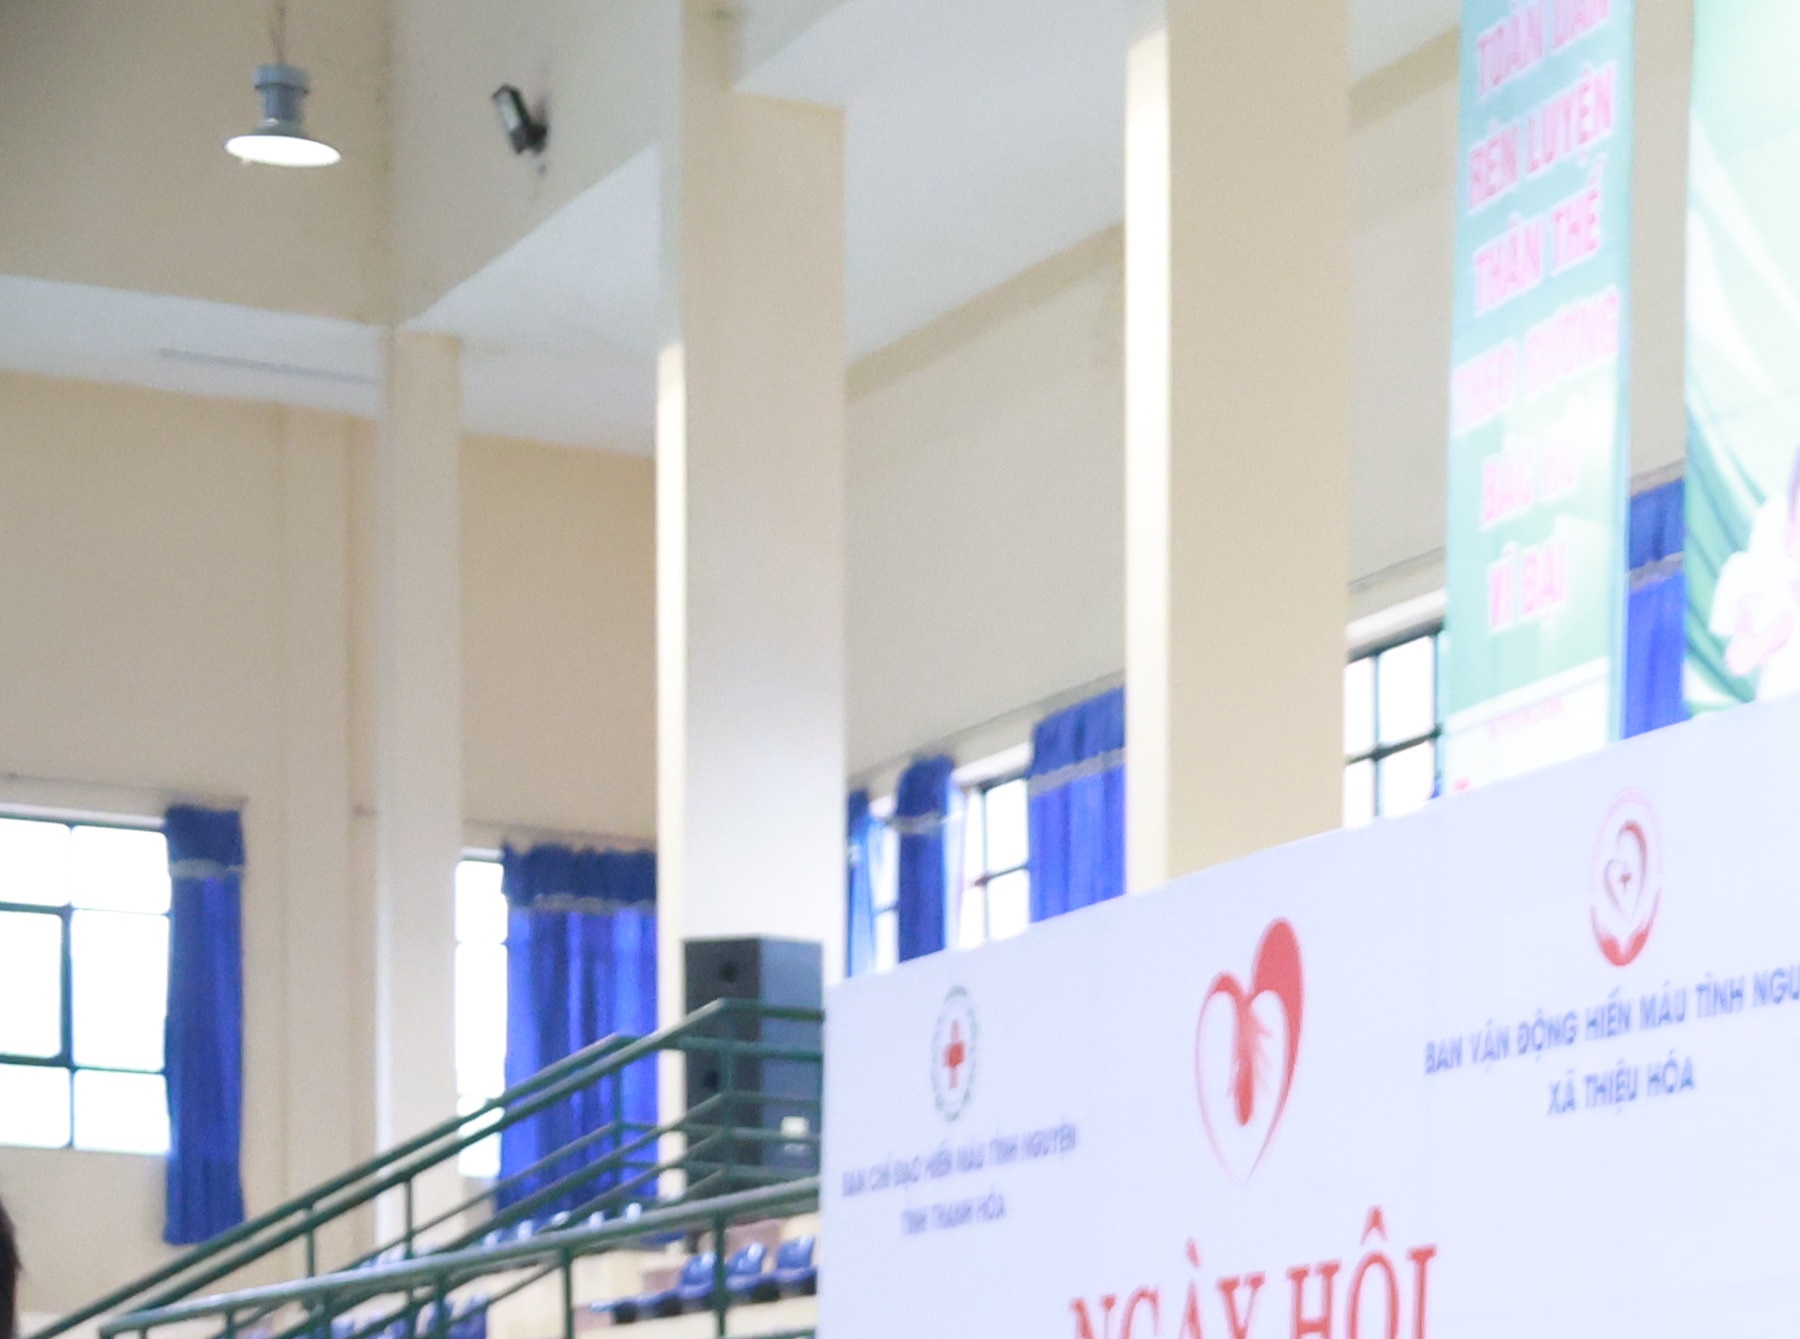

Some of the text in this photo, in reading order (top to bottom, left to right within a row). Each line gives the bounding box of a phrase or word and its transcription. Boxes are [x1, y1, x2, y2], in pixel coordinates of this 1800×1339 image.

[1424, 1034, 1462, 1075] BAN
[1470, 1018, 1511, 1072] VẬN
[1516, 1007, 1577, 1063] ĐỘNG
[1584, 985, 1631, 1041] HIẾN
[1639, 979, 1687, 1032] MÁU
[1695, 971, 1745, 1020] TÌNH
[1547, 1048, 1696, 1117] XÃ THIỆU HÓA
